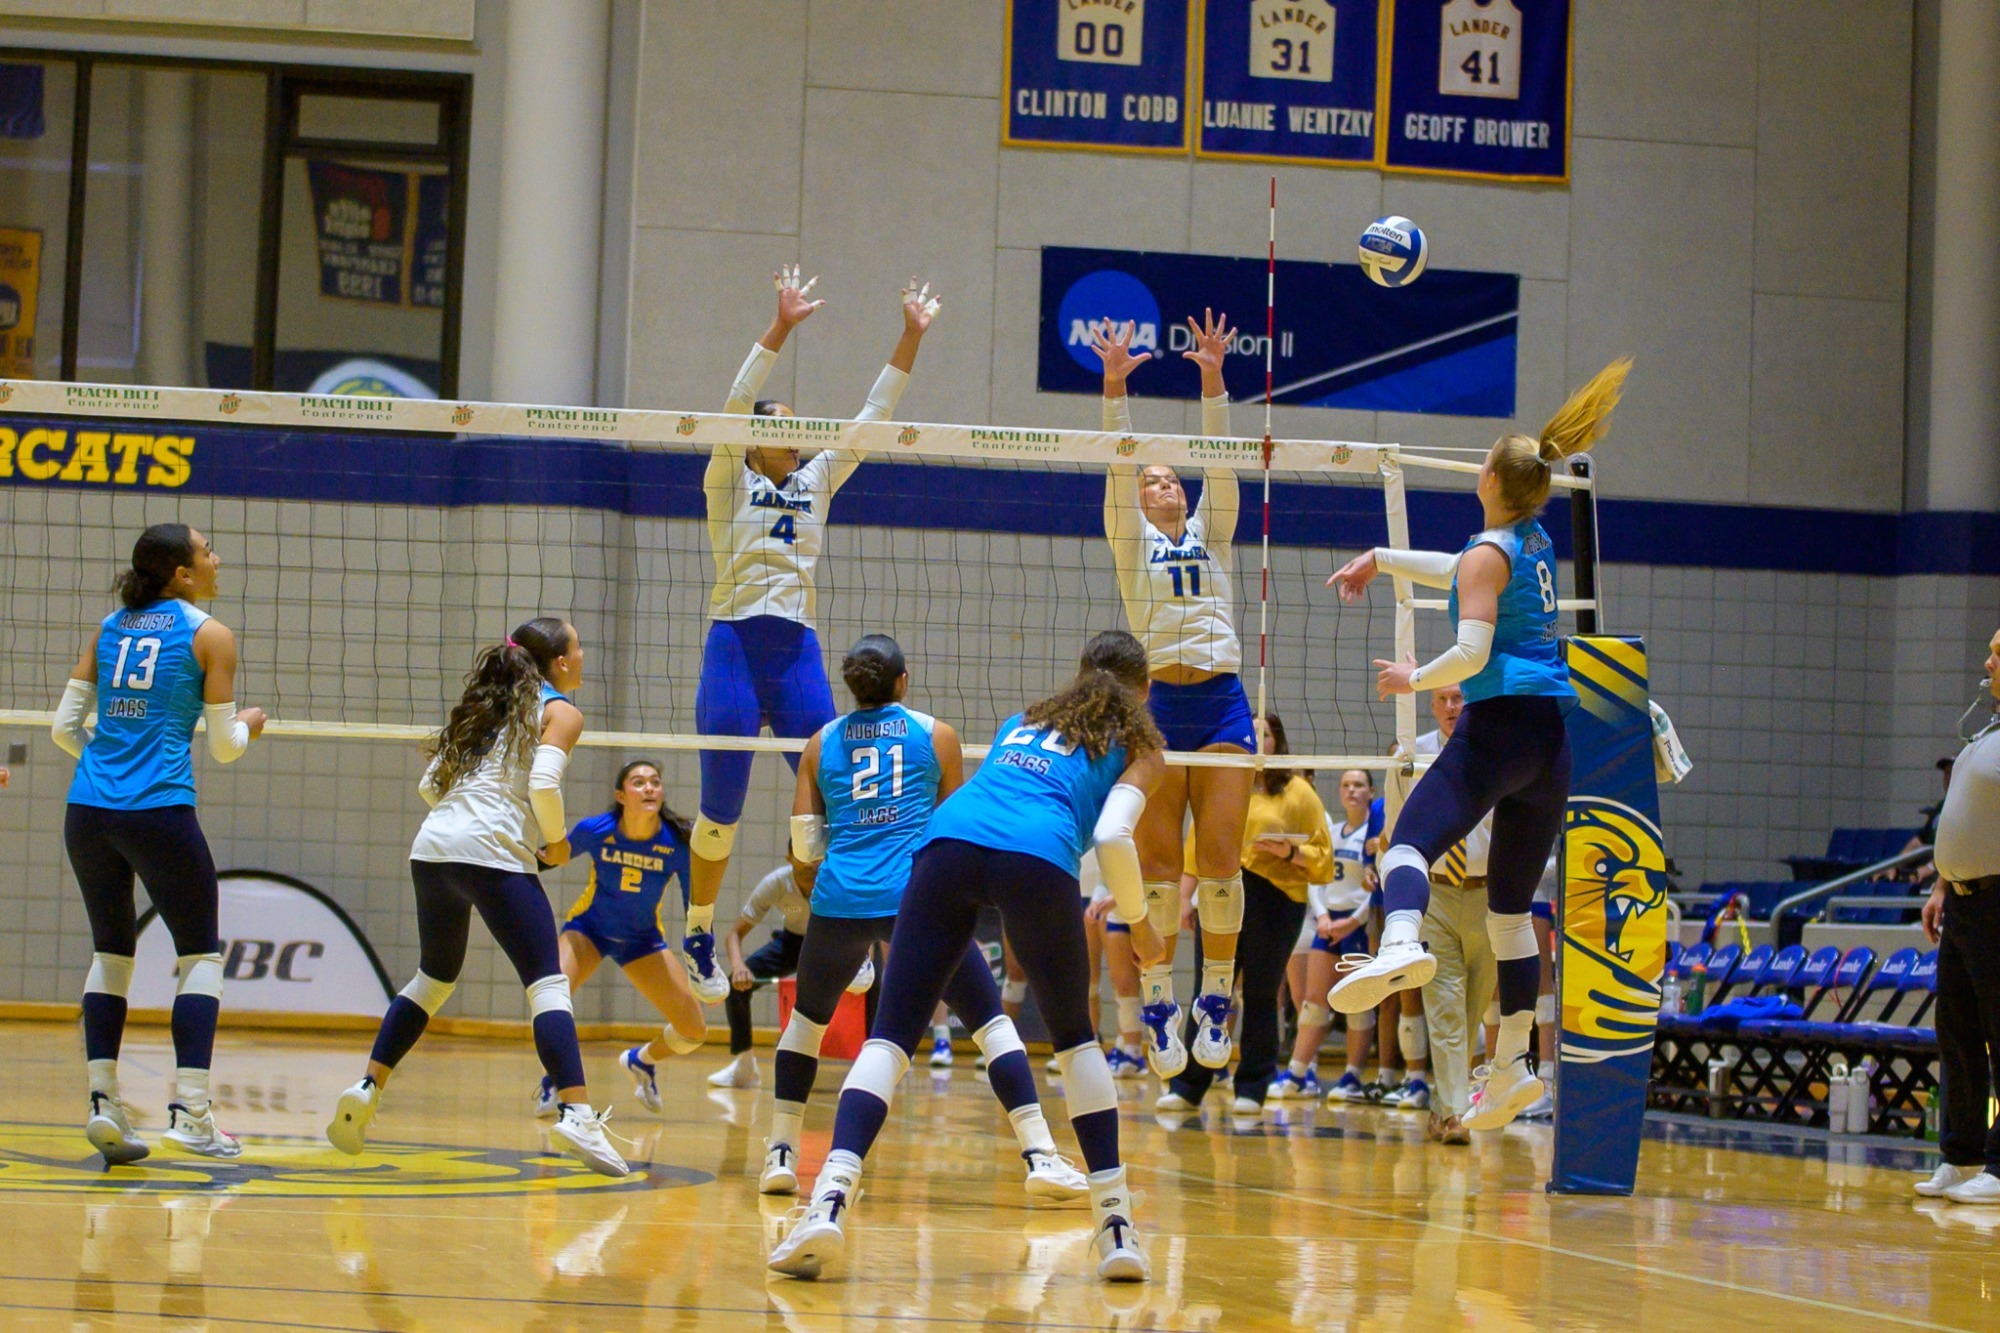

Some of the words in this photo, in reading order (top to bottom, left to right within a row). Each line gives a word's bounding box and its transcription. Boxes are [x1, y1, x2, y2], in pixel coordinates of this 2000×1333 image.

[1259, 8, 1327, 34] LANDER
[1450, 19, 1510, 40] LANDER
[1075, 22, 1123, 56] 00
[1271, 38, 1311, 74] 31
[1461, 50, 1499, 84] 41
[1017, 89, 1107, 119] CLINTON
[1123, 94, 1178, 123] COBB
[1204, 101, 1276, 131] LUANNE
[1288, 106, 1374, 137] WENTZKY
[1405, 113, 1467, 143] GEOFF
[1473, 118, 1550, 149] BROWER
[1369, 226, 1403, 242] molten
[526, 408, 578, 421] PEACH
[582, 411, 618, 423] BELT
[528, 420, 618, 432] Conference
[770, 514, 796, 545] 4
[1167, 565, 1200, 597] 11
[1536, 560, 1556, 614] 8
[118, 613, 175, 631] AUGUSTA
[112, 637, 162, 690] 13
[107, 697, 147, 718] JAGS
[845, 718, 909, 741] AUGUSTA
[852, 744, 904, 800] 21
[994, 750, 1051, 775] JAGS
[853, 807, 898, 825] JAGS
[601, 848, 664, 871] LANDER
[620, 867, 643, 893] 2
[173, 939, 325, 982] BC
